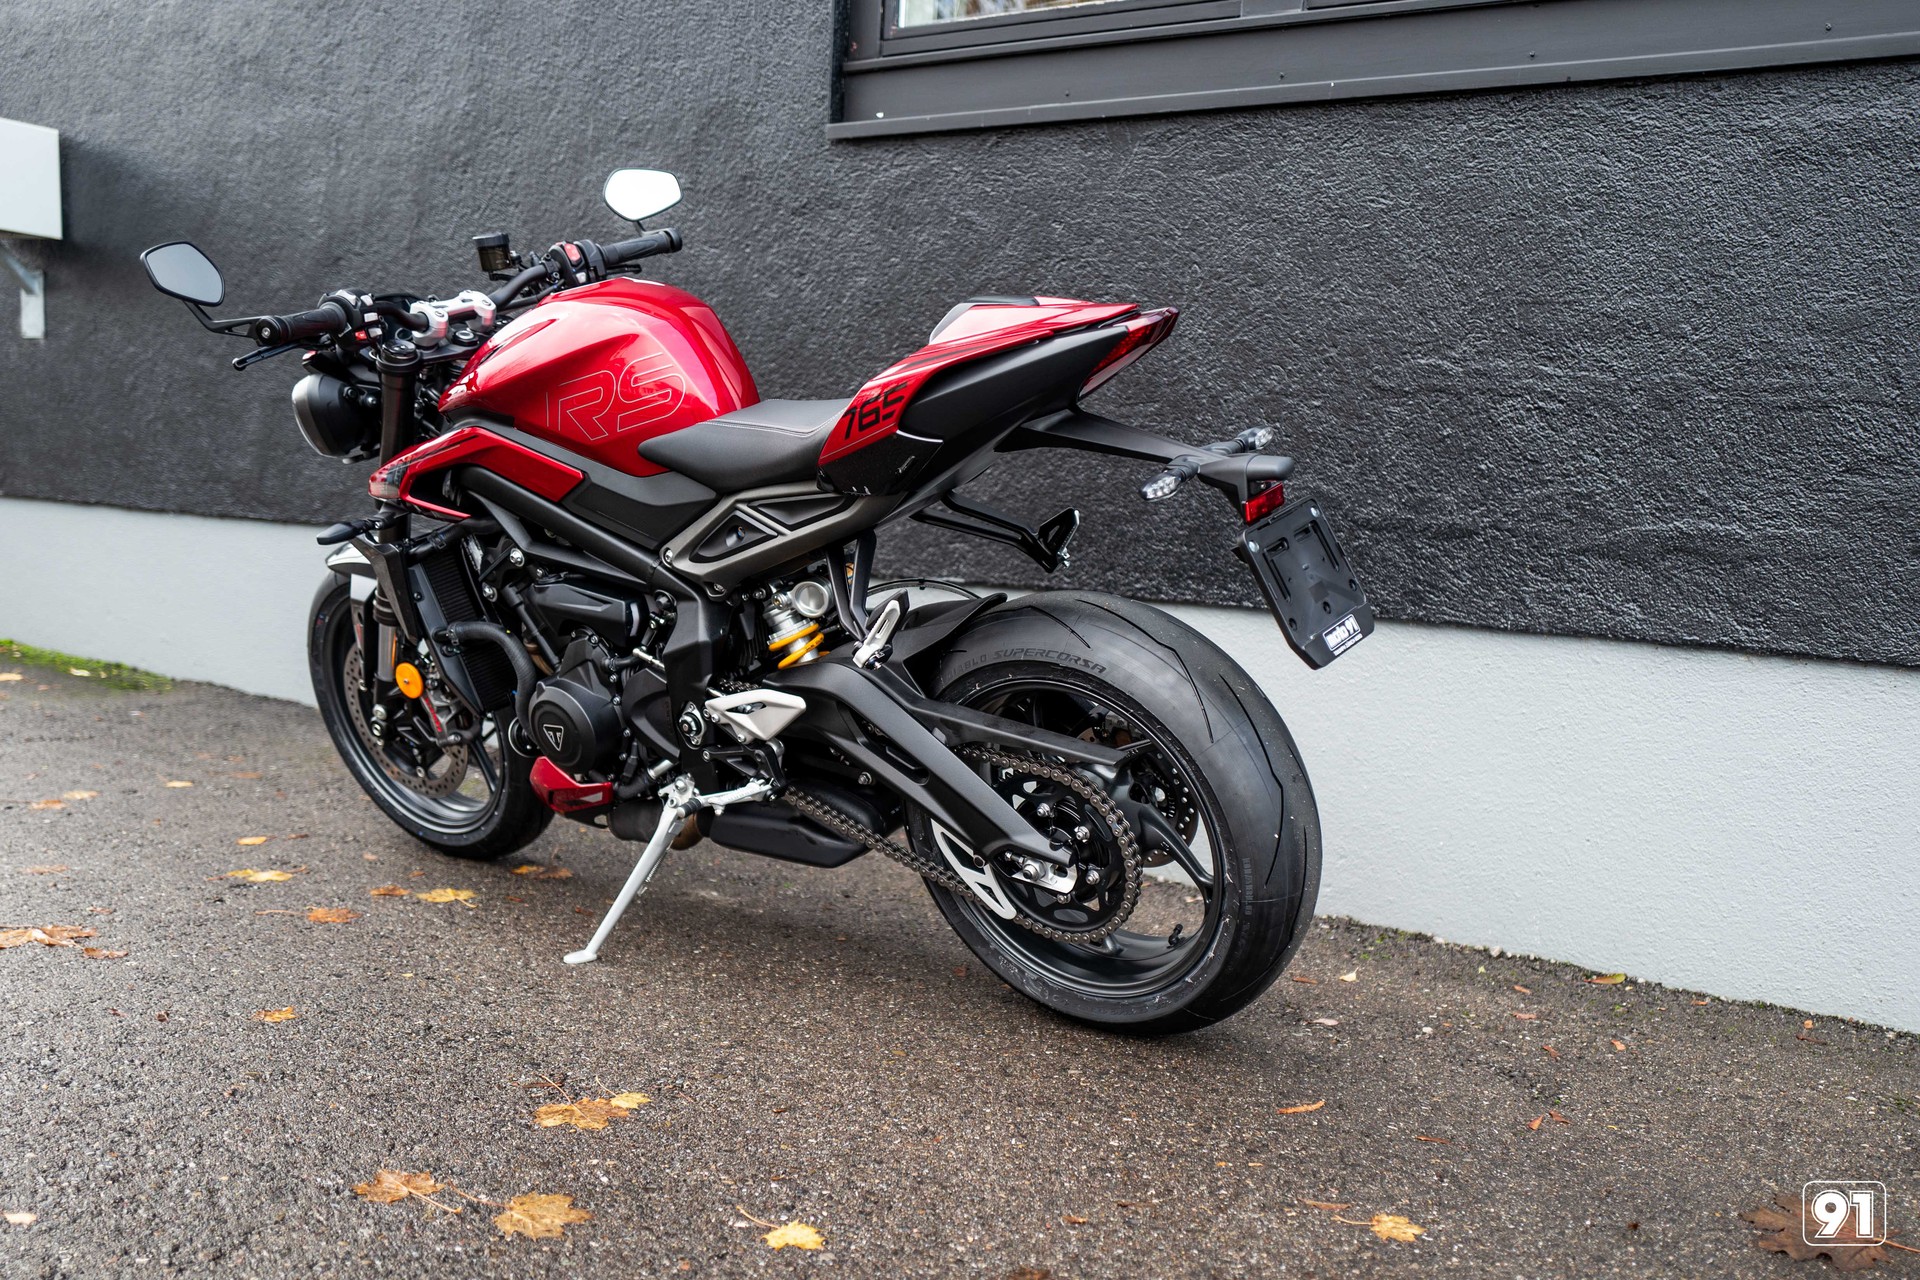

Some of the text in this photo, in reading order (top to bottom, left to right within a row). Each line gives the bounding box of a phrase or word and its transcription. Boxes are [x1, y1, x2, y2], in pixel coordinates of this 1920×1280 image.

[546, 351, 686, 441] RS
[842, 381, 909, 440] 765
[993, 647, 1107, 675] SUPERCORSA
